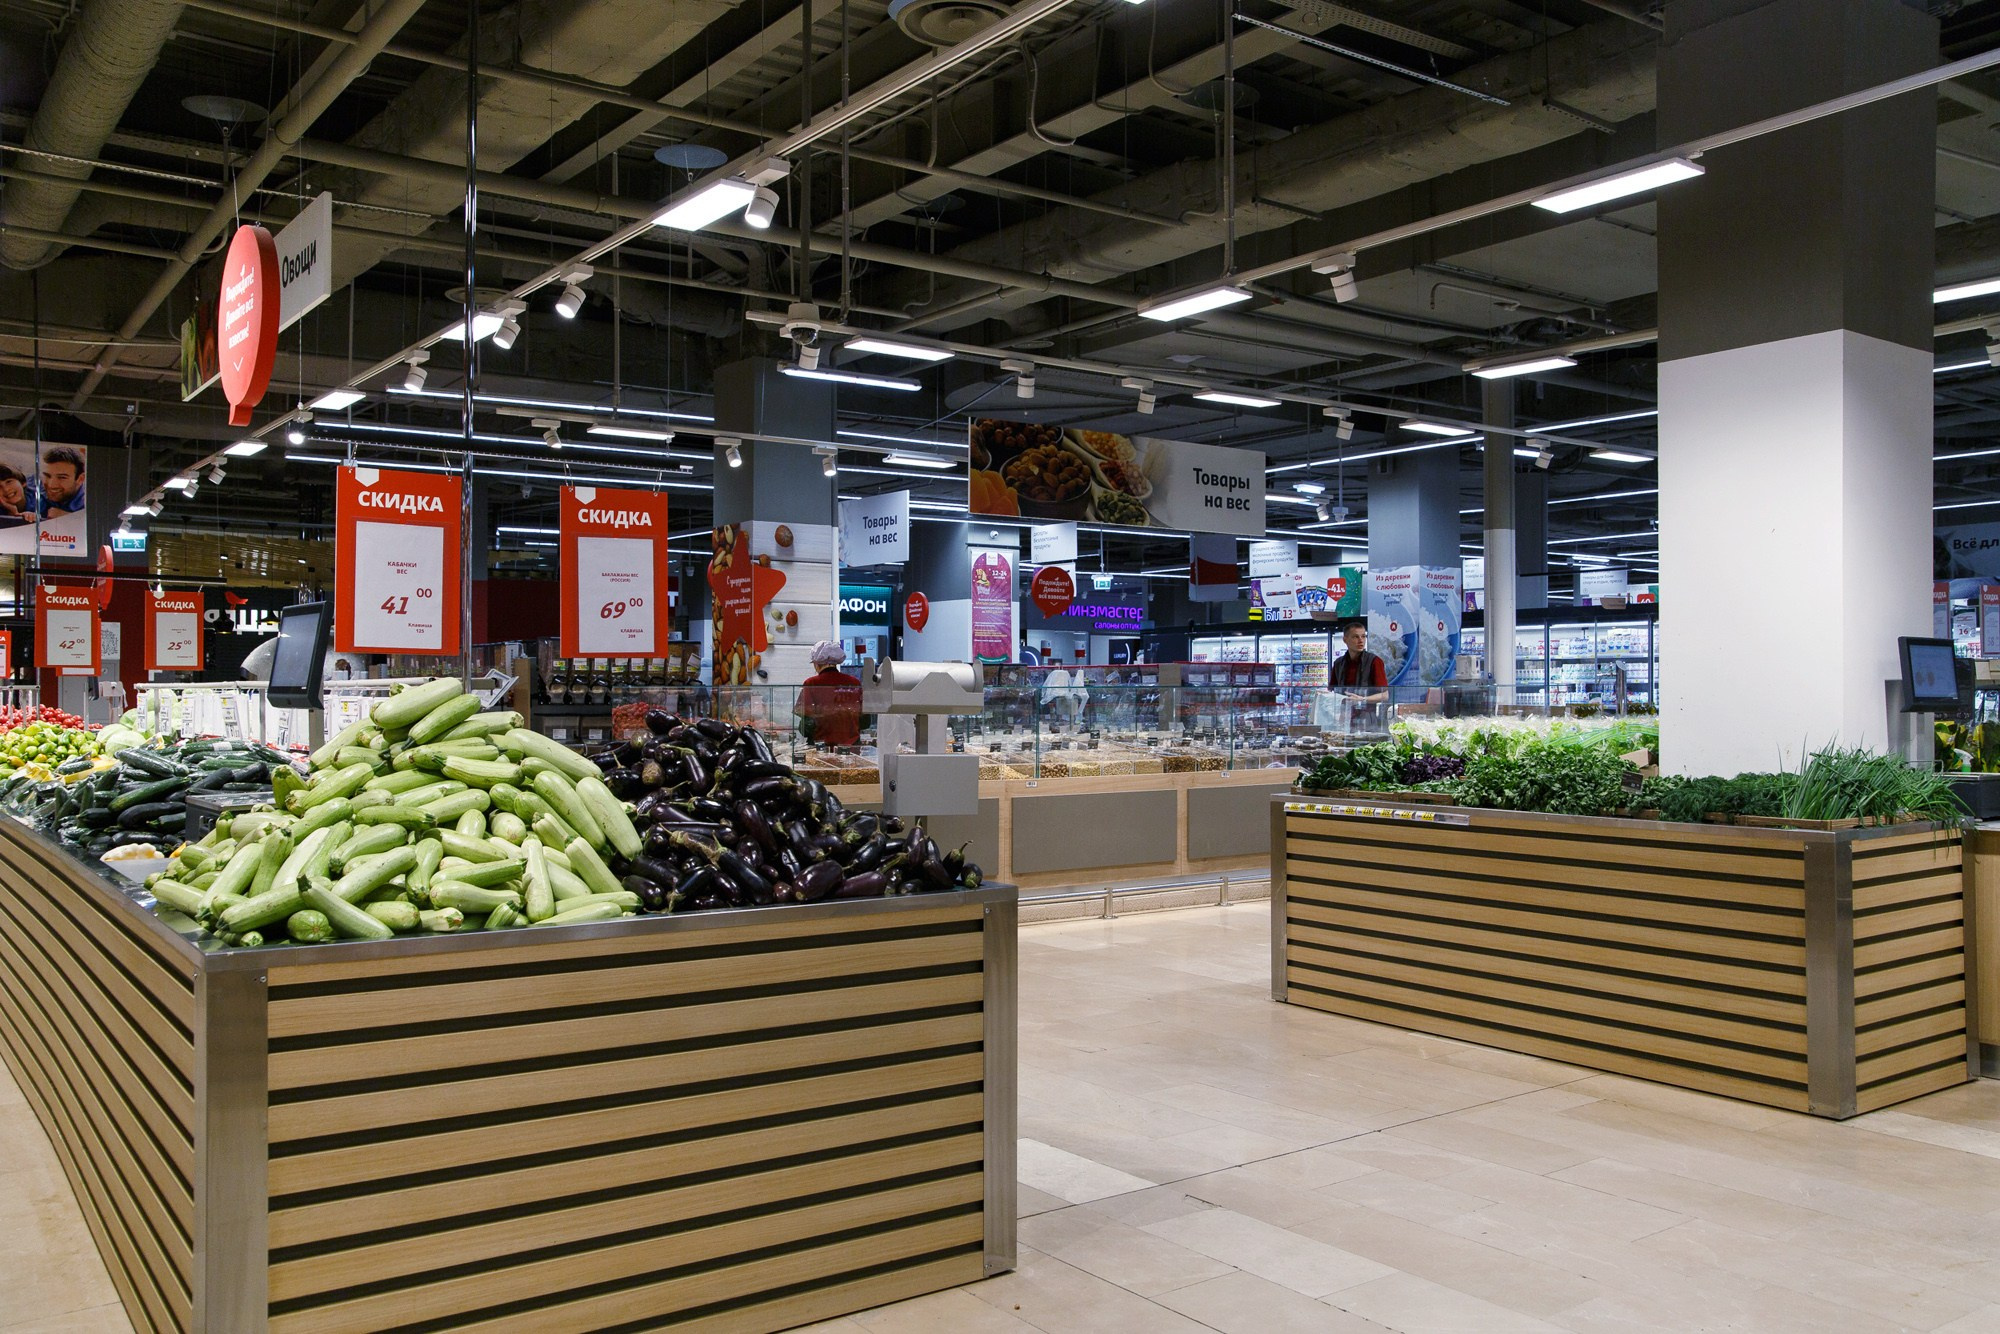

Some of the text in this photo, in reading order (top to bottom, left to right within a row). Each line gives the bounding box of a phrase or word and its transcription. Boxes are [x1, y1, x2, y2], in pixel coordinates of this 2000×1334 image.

[282, 240, 317, 288] Овощи
[1192, 467, 1250, 493] Товары
[357, 490, 444, 515] СКИДКА
[1204, 495, 1250, 511] на вес
[577, 508, 653, 529] СКИДКА
[862, 515, 898, 530] Товары
[869, 532, 898, 546] на вес
[1953, 537, 2000, 550] Всё дл
[1384, 573, 1411, 582] деревни
[1434, 573, 1455, 581] деревни
[1430, 582, 1455, 590] любовью
[45, 595, 90, 606] СКИДКА
[154, 600, 195, 610] СКИДКА
[380, 587, 433, 615] 41 00
[838, 597, 887, 613] АФОН
[600, 597, 644, 620] 69 00
[1282, 609, 1293, 619] 13
[1094, 621, 1119, 630] салоны
[59, 640, 75, 650] 42
[167, 641, 183, 651] 25
